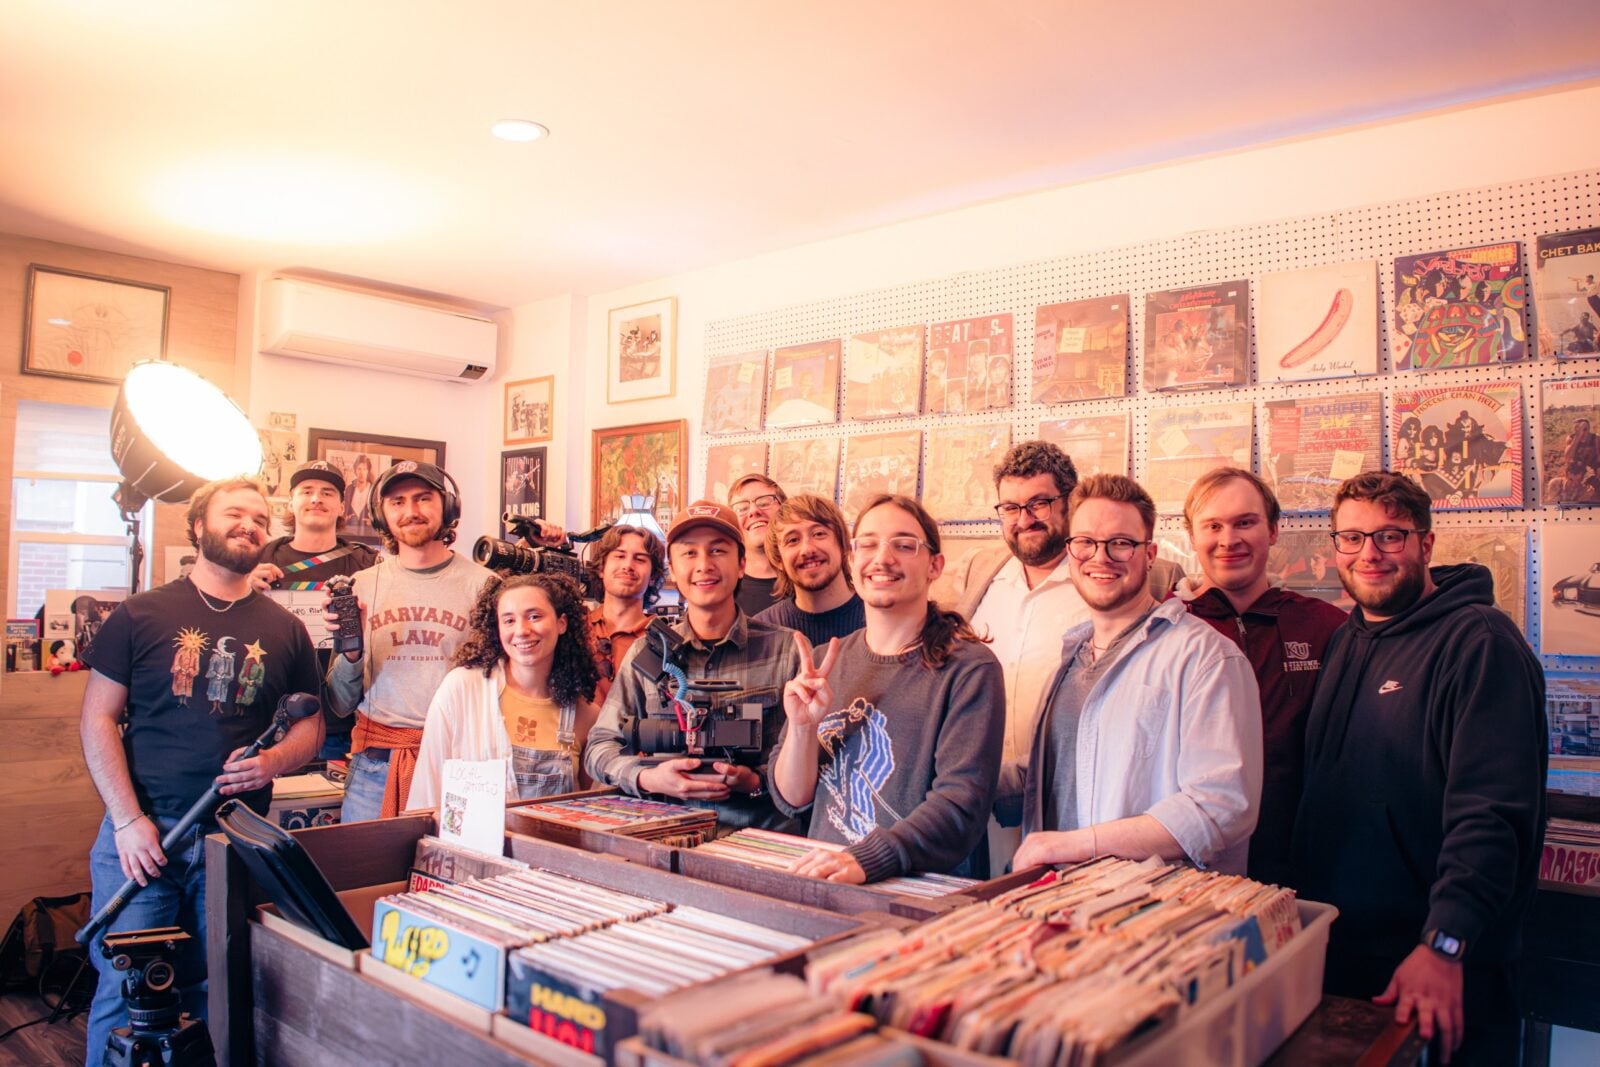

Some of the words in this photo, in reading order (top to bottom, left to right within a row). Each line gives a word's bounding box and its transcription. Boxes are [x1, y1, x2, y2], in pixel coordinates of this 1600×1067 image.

[1540, 246, 1574, 258] CHET
[1571, 380, 1600, 389] CLASH
[1417, 394, 1449, 414] HOTTER
[1450, 392, 1476, 400] THAN
[1477, 394, 1498, 410] HELL
[521, 502, 540, 517] KING
[368, 606, 467, 632] HARVARD
[390, 629, 445, 647] LAW
[1284, 641, 1310, 660] KU
